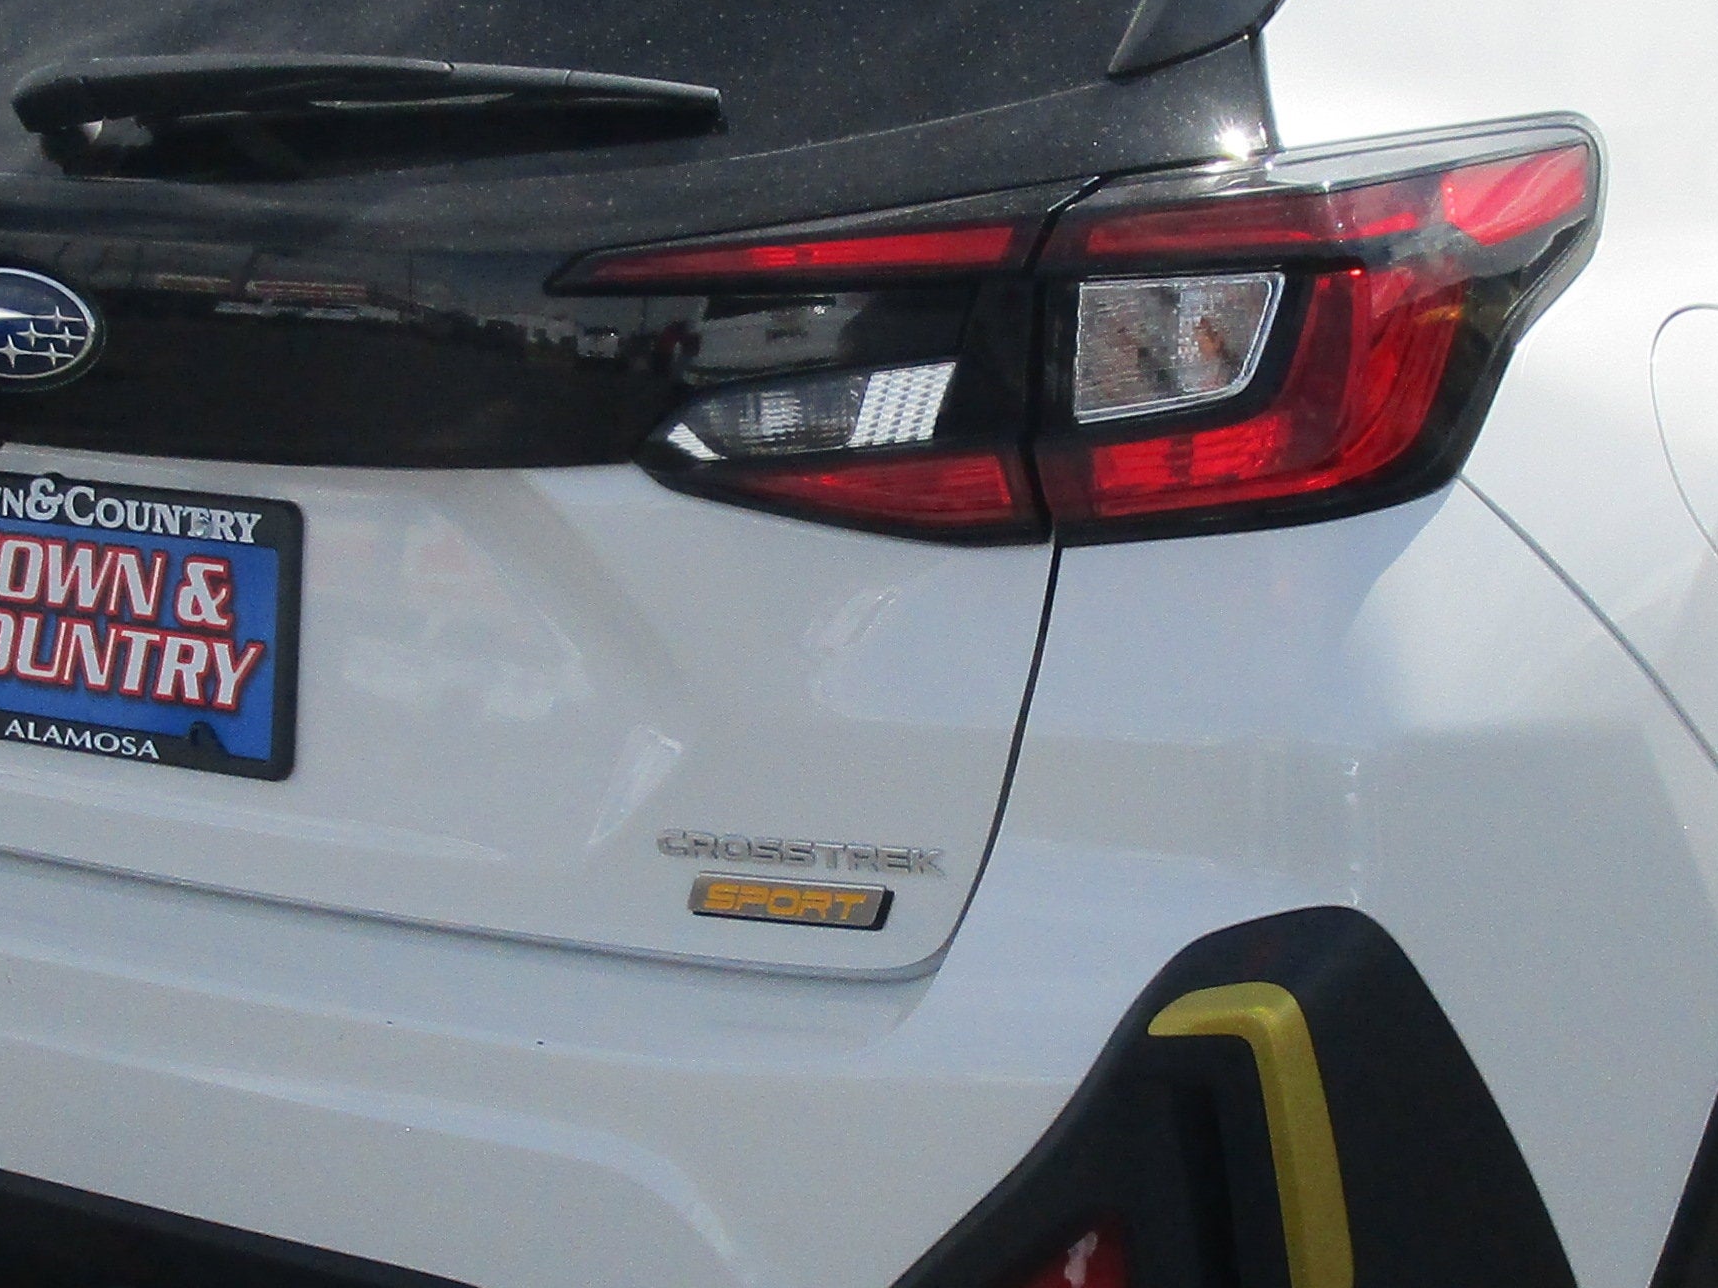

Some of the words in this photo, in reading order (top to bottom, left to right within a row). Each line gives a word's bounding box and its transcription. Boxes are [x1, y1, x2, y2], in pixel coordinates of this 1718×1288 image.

[174, 556, 234, 631] &
[4, 718, 161, 760] ALAMOSA
[656, 827, 948, 877] CROSSTREK
[703, 881, 868, 921] SPORT
